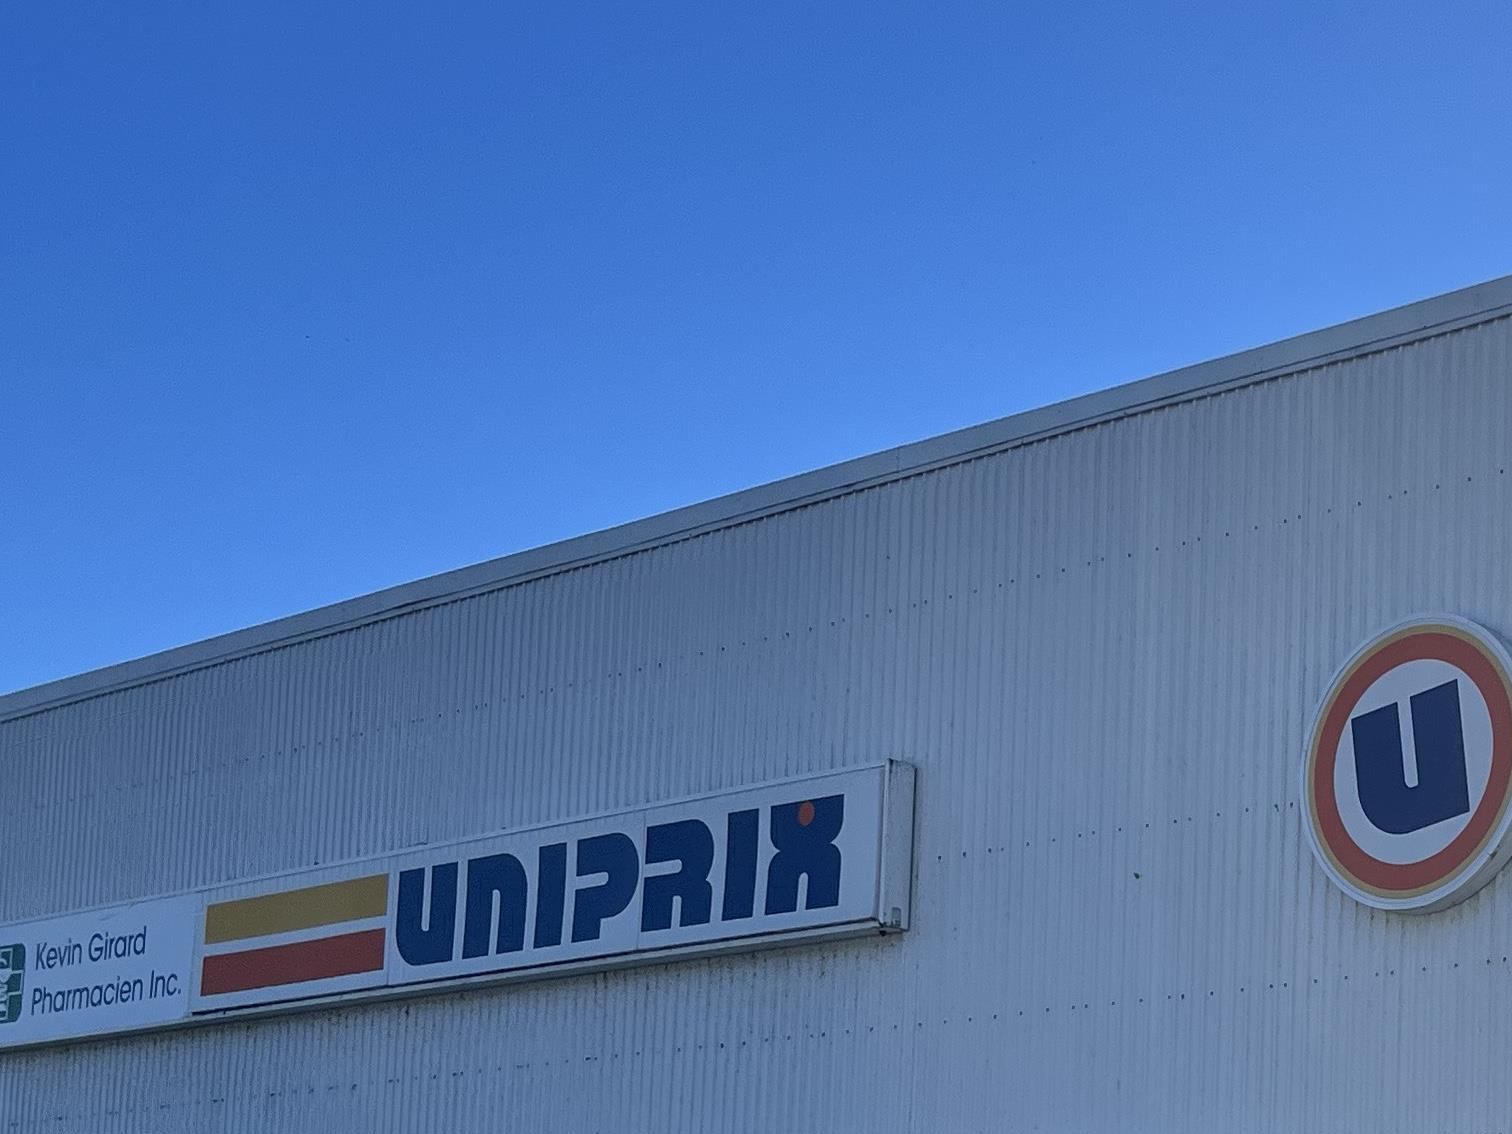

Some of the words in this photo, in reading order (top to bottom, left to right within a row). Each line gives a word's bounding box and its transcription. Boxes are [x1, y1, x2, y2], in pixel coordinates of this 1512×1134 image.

[1351, 679, 1470, 835] U
[396, 794, 845, 966] UNIPRIX
[31, 975, 143, 1016] Pharmacien
[150, 970, 181, 999] Inc.
[35, 938, 82, 970] Kevin
[88, 925, 147, 962] Girard
